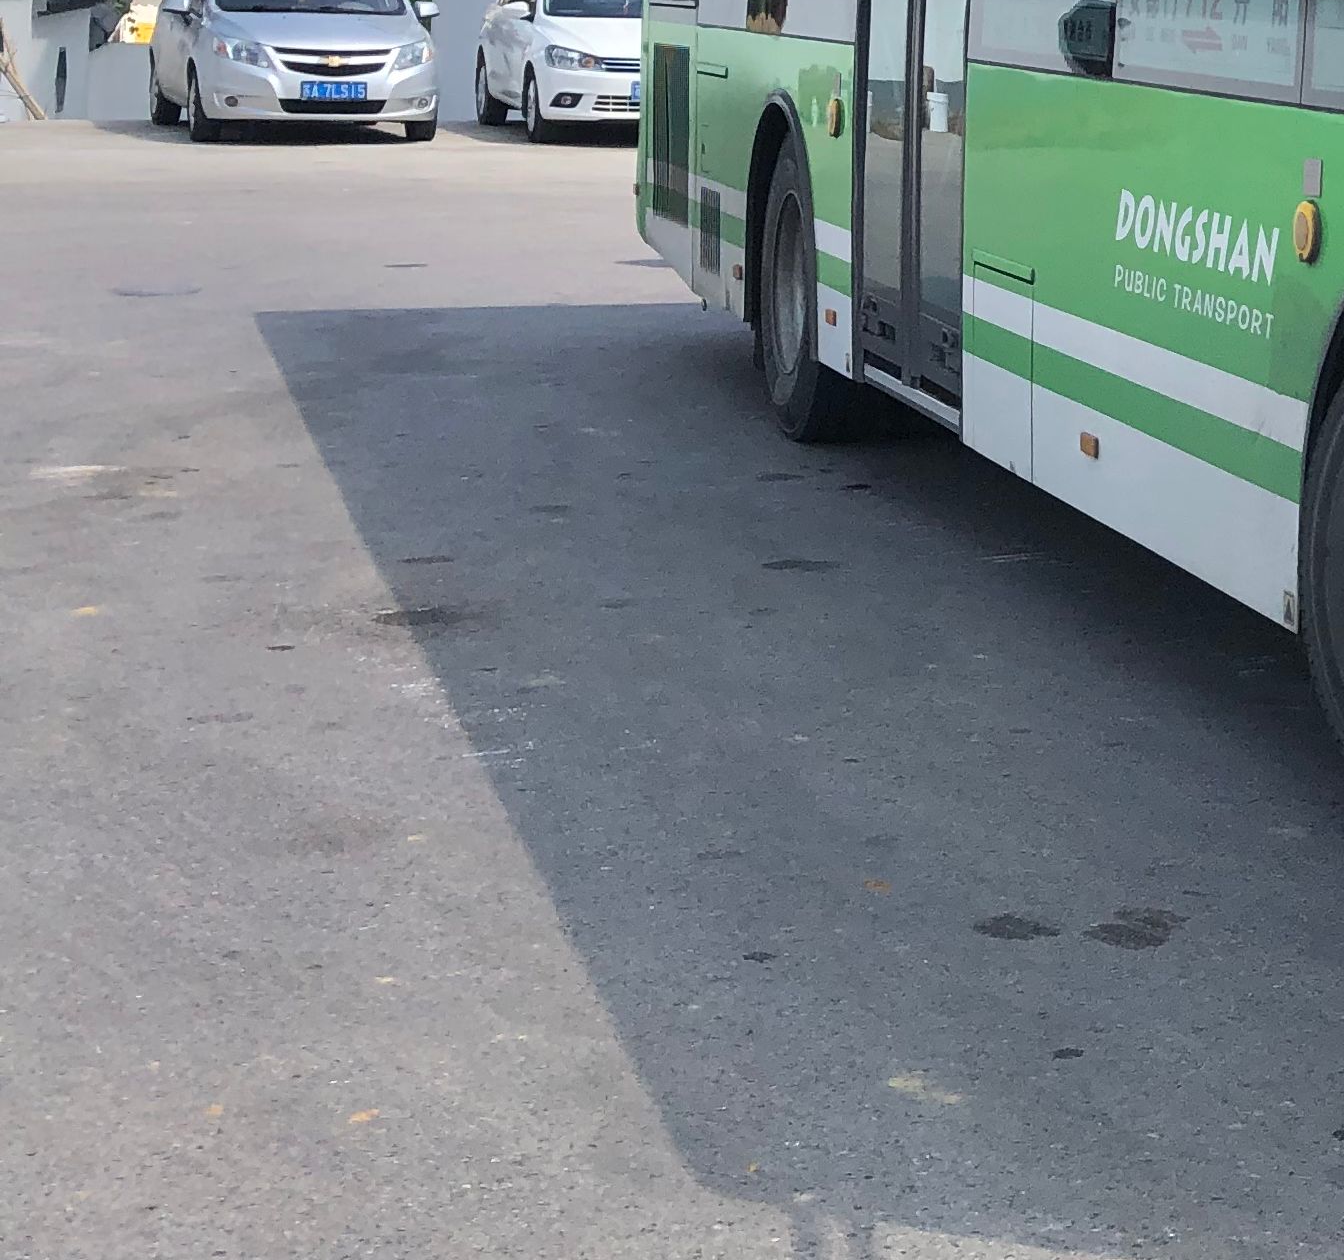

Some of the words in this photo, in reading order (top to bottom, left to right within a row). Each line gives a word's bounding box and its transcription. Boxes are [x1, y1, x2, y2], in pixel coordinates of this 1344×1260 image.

[1115, 188, 1280, 286] DONGSHAN
[1114, 264, 1167, 302] PUBLIC
[1173, 283, 1275, 340] TRANSPORT
